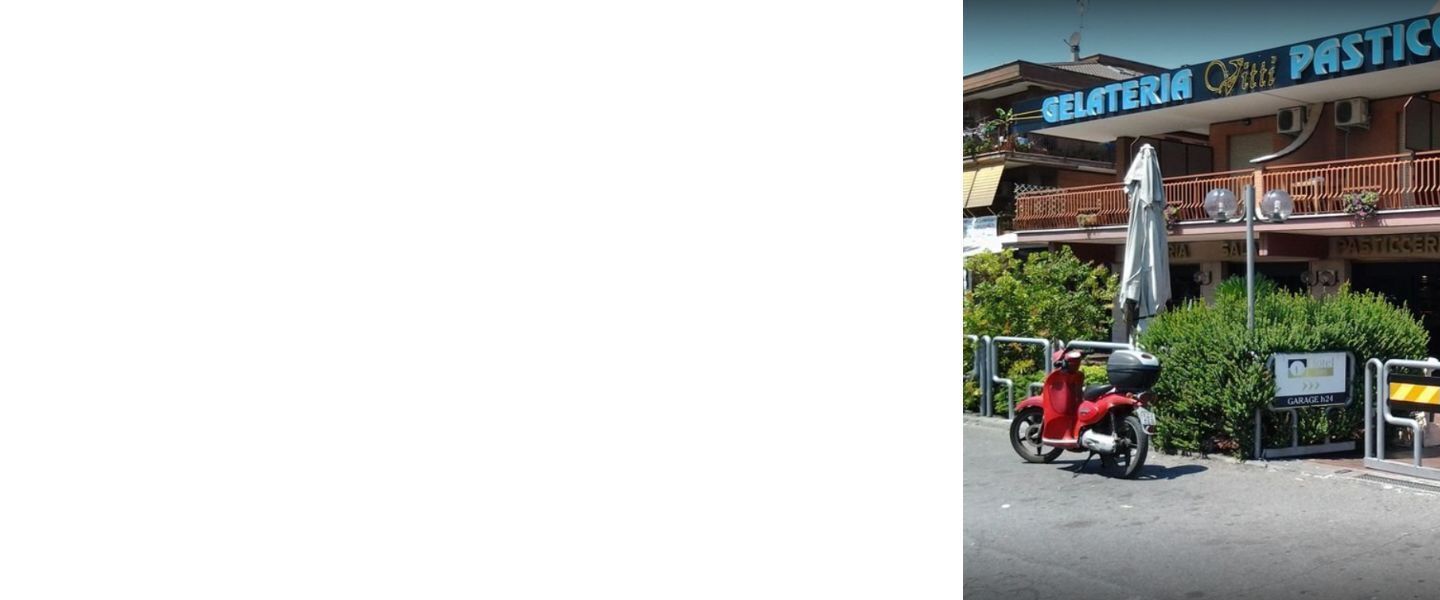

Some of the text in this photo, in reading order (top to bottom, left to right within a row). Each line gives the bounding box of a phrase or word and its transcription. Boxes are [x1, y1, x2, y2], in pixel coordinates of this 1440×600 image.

[1042, 69, 1193, 123] GELATERIA
[1204, 56, 1278, 96] Vitti
[1287, 395, 1334, 405] GARAGE h24
